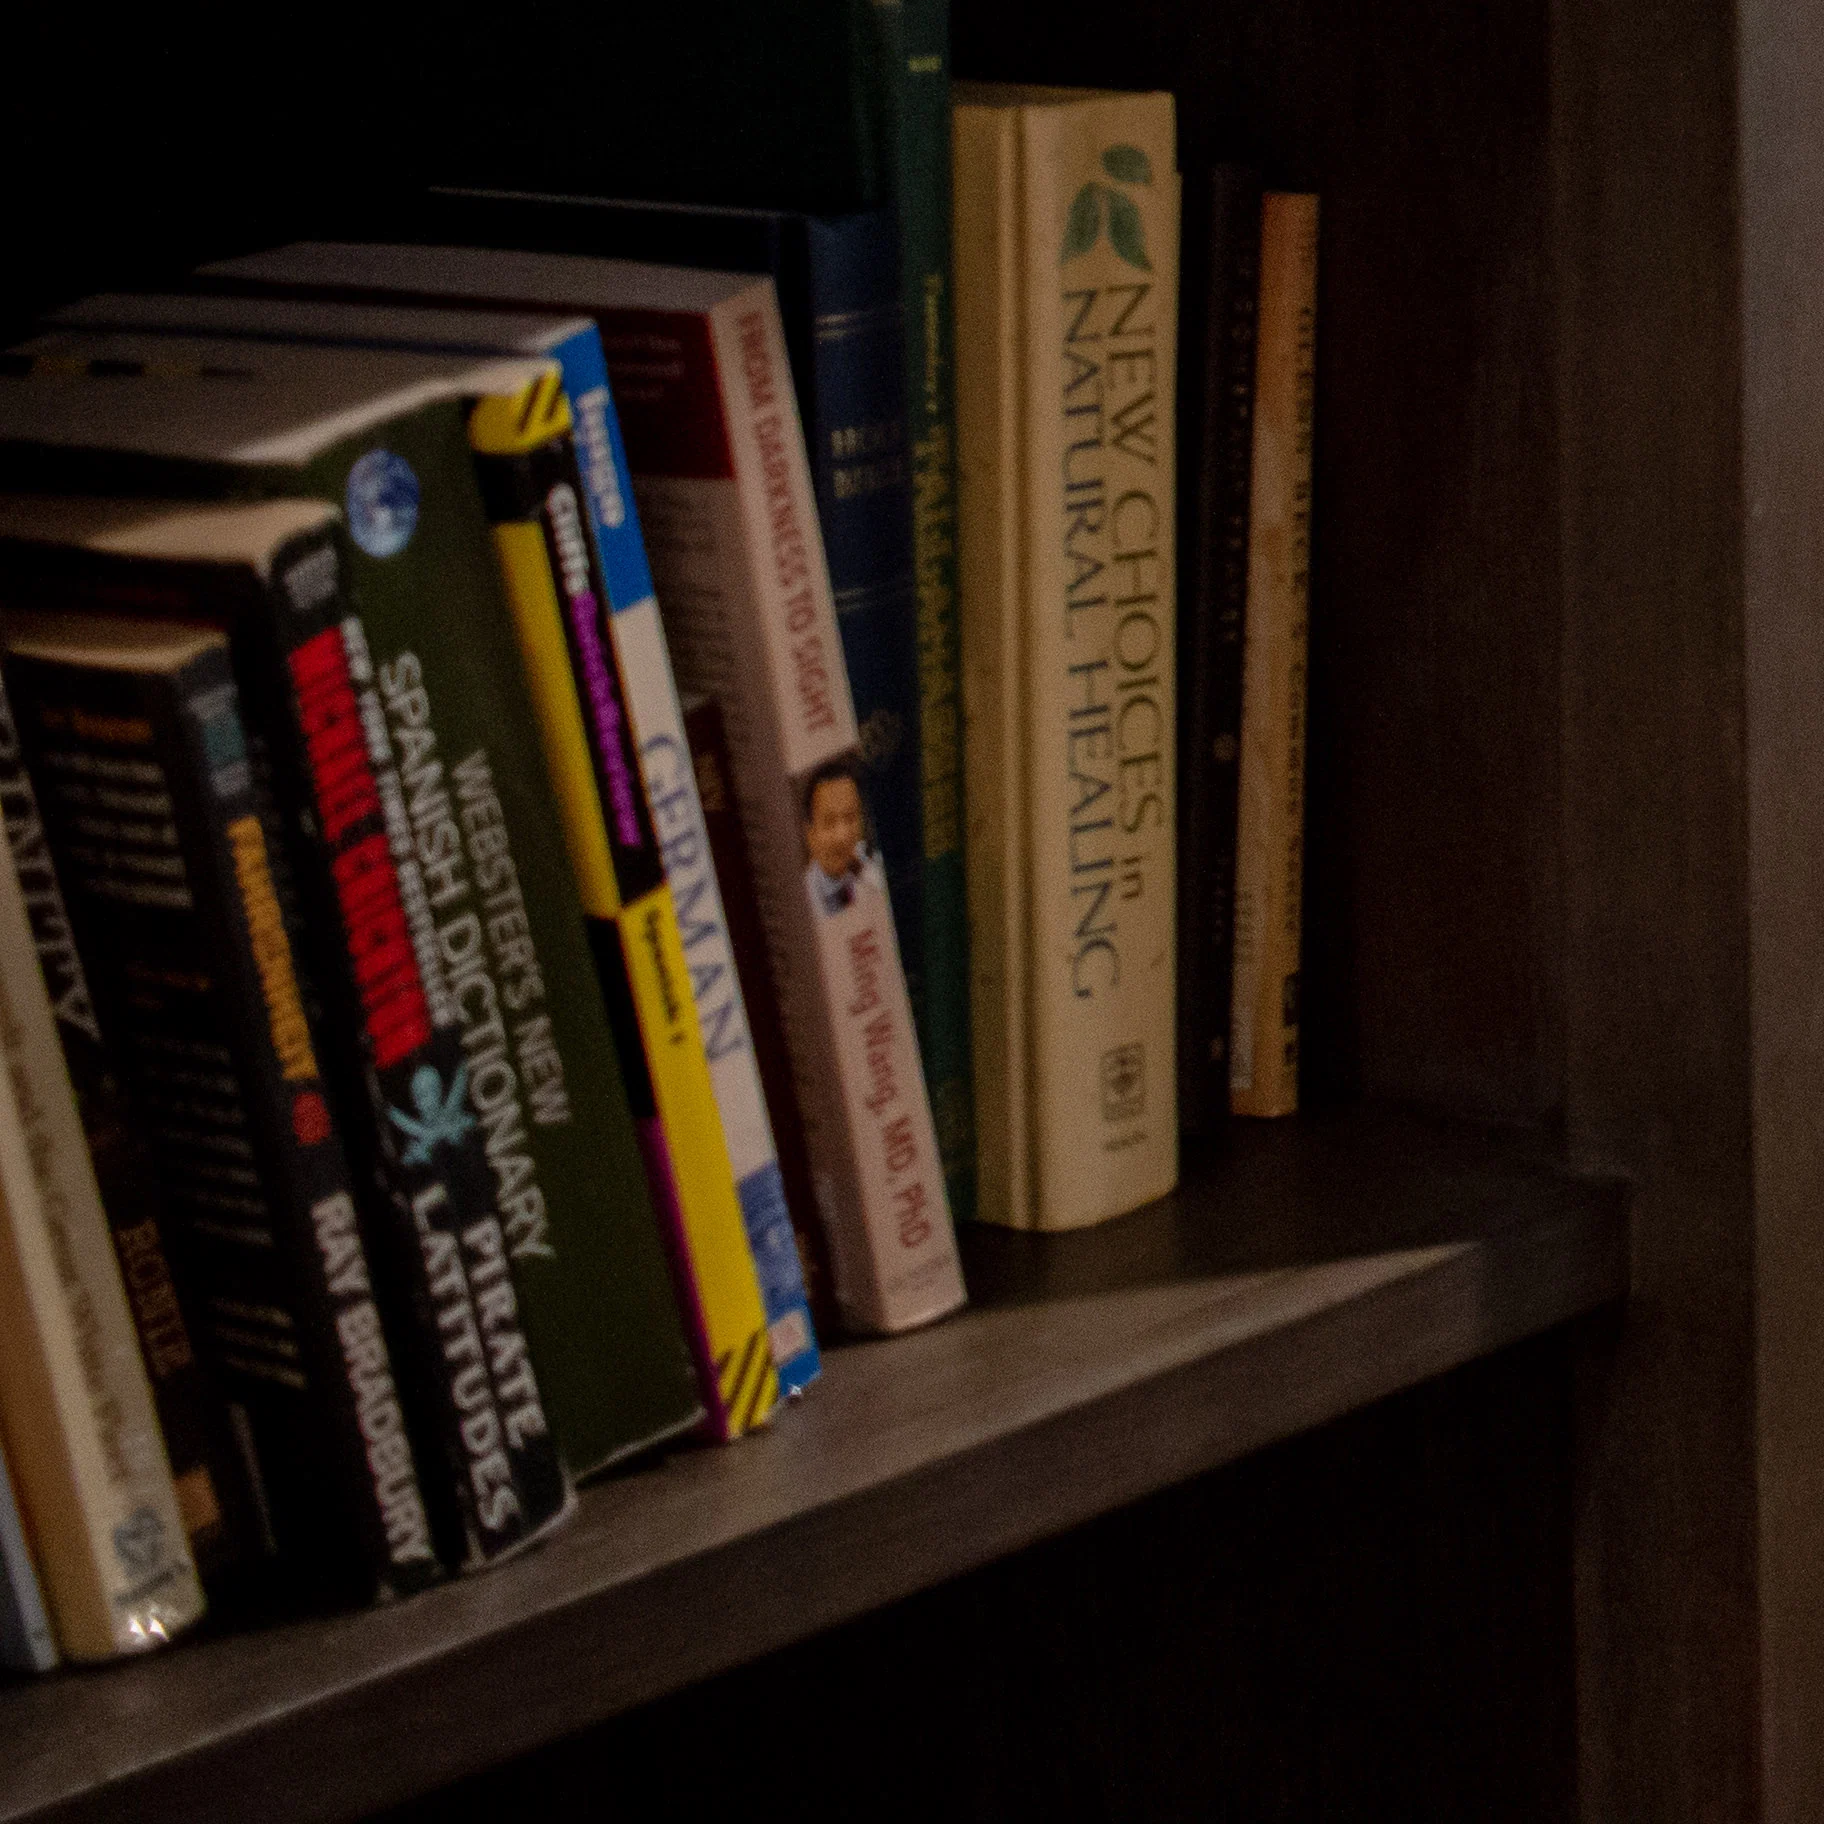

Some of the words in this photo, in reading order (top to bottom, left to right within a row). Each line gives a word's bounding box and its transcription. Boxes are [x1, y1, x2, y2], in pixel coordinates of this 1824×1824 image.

[736, 310, 776, 407] FROM
[1106, 283, 1157, 466] NEW
[749, 418, 808, 586] DARKNESS
[1061, 288, 1111, 642] NATURAL
[778, 588, 814, 629] TO
[786, 635, 837, 734] SIGHT
[1111, 490, 1165, 834] CHOICES
[638, 734, 744, 1064] GERMAN
[1066, 661, 1122, 1002] HEALING
[1120, 858, 1151, 900] in
[376, 650, 457, 901] SPANISH
[432, 920, 553, 1262] DICTIONARY
[451, 748, 549, 1017] WEBSTER'S
[509, 1024, 570, 1126] NEW
[844, 929, 885, 1014] Ming
[852, 1021, 903, 1111] Wang,
[865, 1118, 913, 1176] MD,
[309, 1194, 365, 1297] RAY
[891, 1184, 933, 1249] PhD
[409, 1185, 521, 1532] LATITUDES
[463, 1221, 546, 1450] PIRATE
[332, 1313, 433, 1566] BRADBURY
